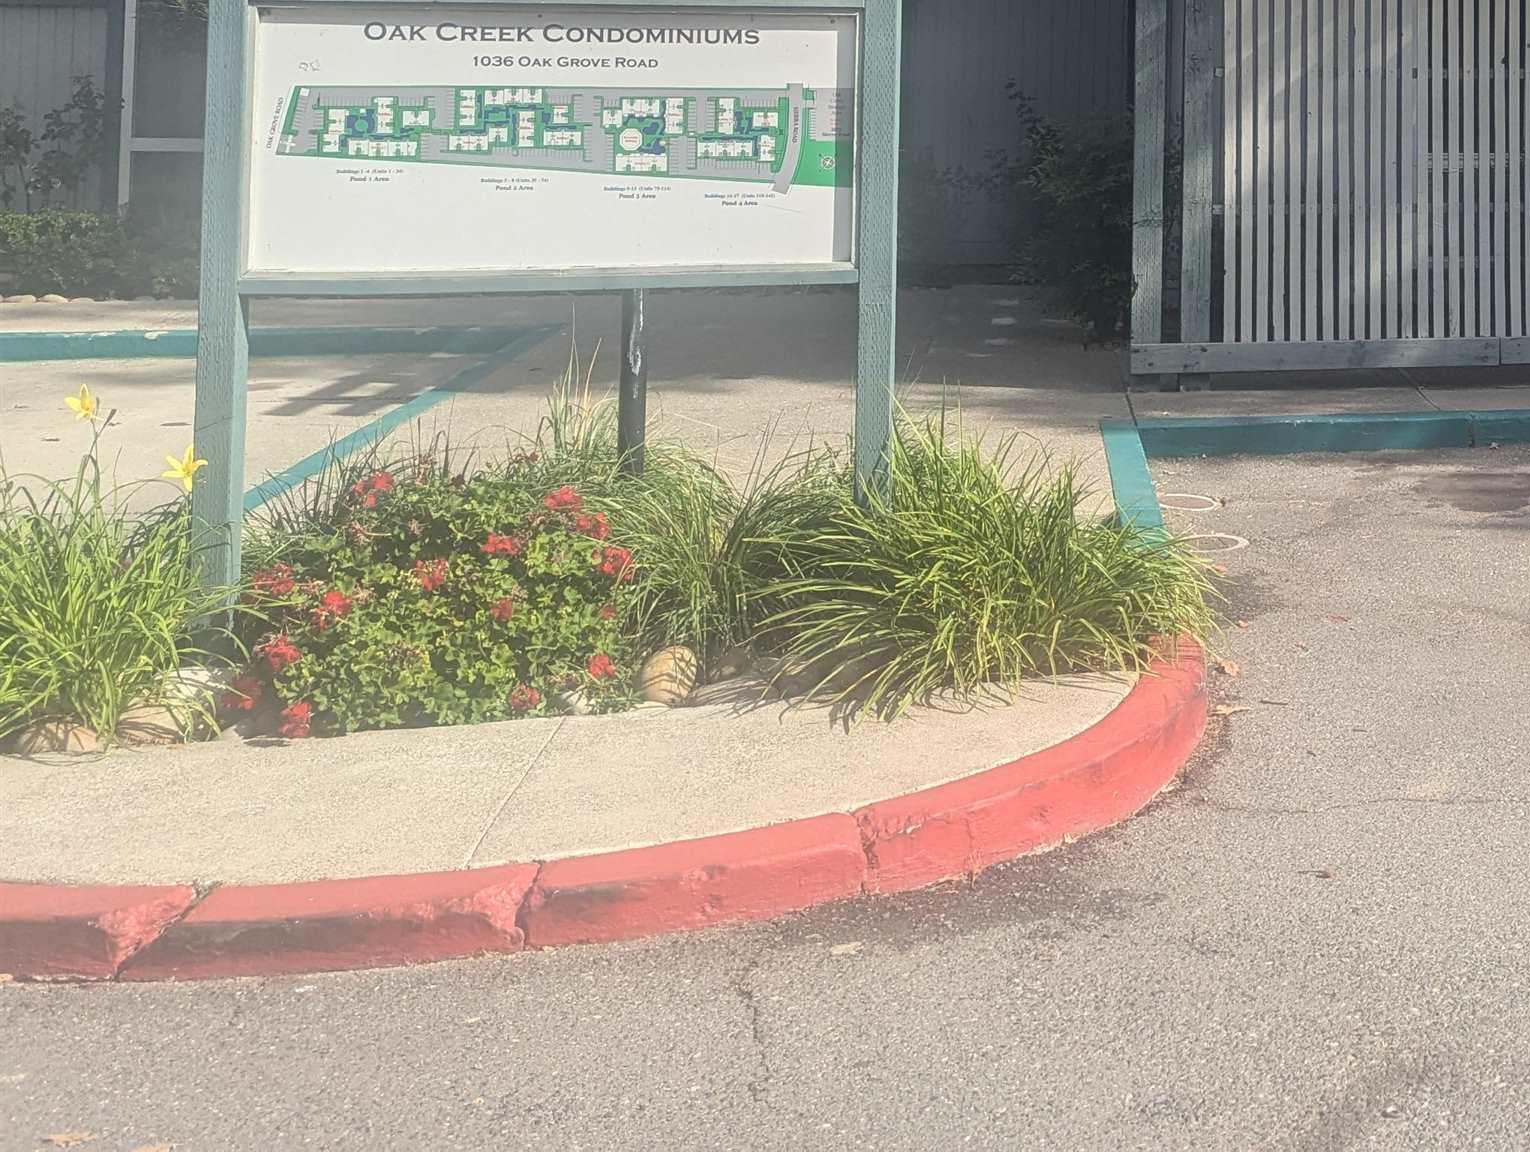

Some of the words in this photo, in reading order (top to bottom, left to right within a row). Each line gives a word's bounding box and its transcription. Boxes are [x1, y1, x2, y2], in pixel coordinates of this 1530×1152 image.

[363, 21, 427, 41] OAK
[436, 22, 535, 42] CREEK
[542, 23, 760, 45] CONDOMINIUMS
[473, 55, 514, 67] 1036
[518, 56, 552, 67] OAK
[556, 56, 611, 68] GROVE
[615, 57, 659, 68] ROAD
